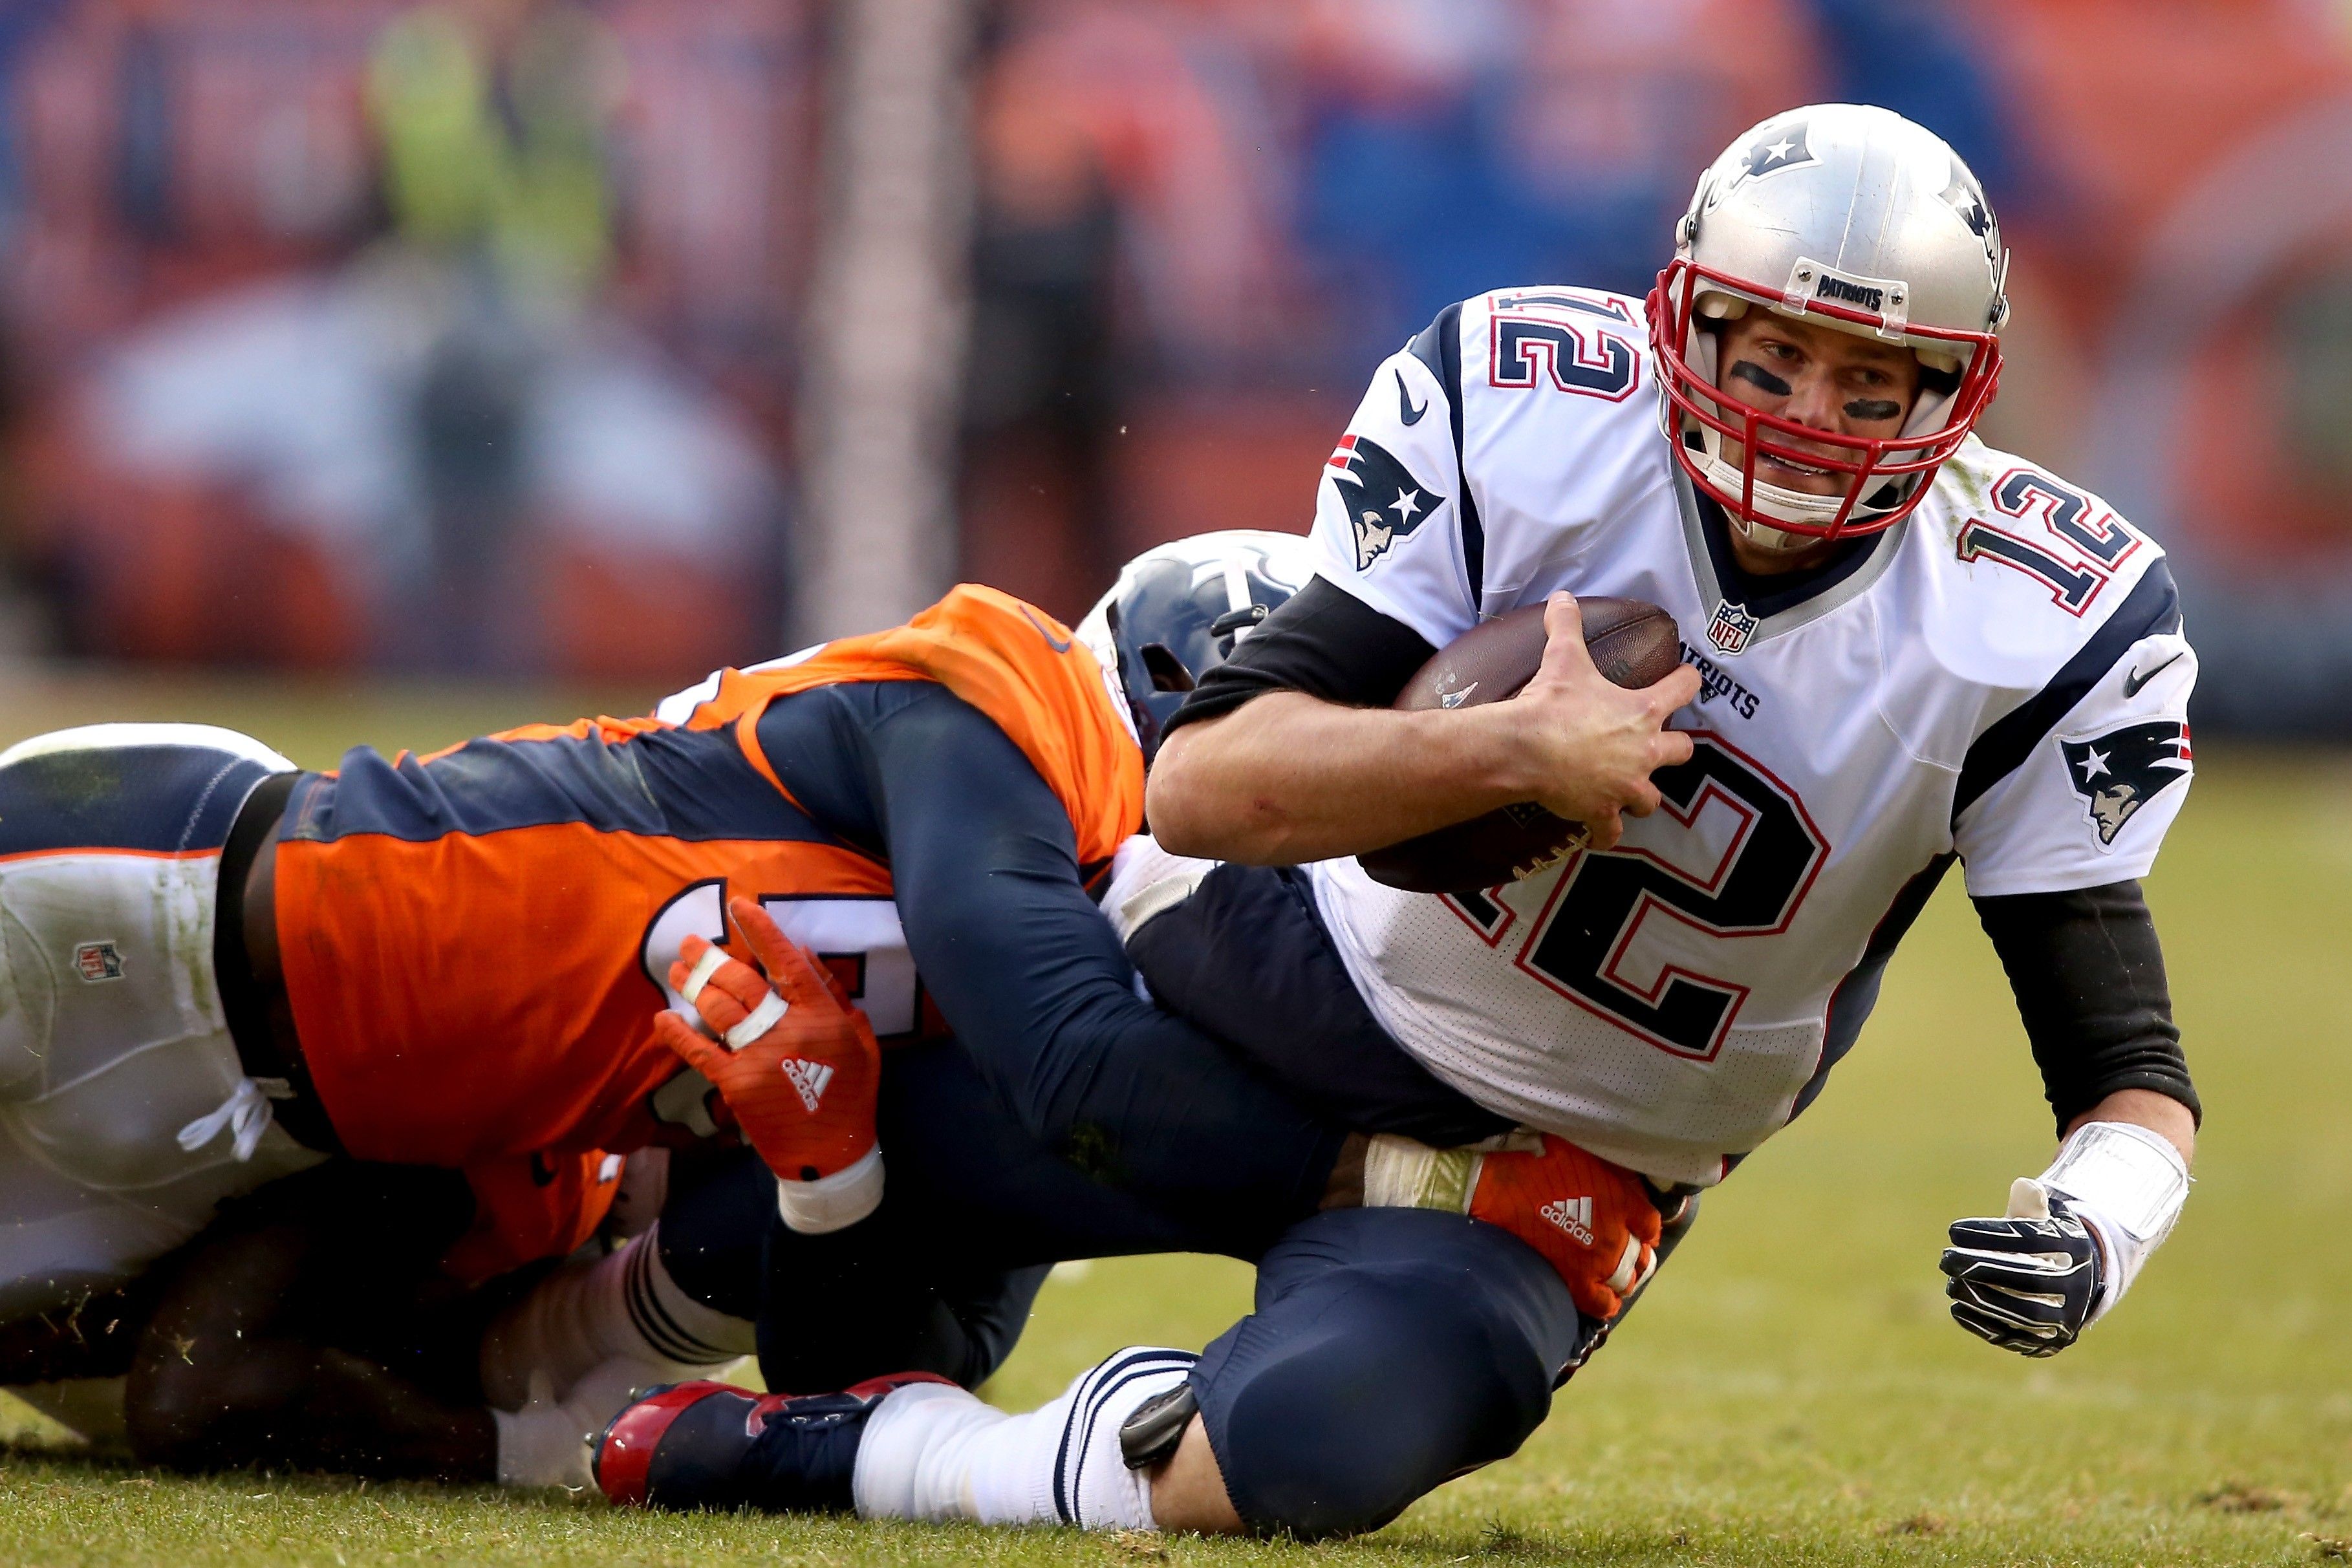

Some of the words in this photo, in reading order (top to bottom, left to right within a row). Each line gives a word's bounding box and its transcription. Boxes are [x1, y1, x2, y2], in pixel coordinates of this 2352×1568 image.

[1816, 274, 1883, 312] PATRIOTS
[1488, 292, 1641, 403] 12
[1957, 468, 2142, 619] 12
[1710, 619, 1742, 650] NFL
[1679, 640, 1760, 720] TRIOTS
[782, 1059, 818, 1111] adidas
[1540, 1205, 1594, 1246] adidas
